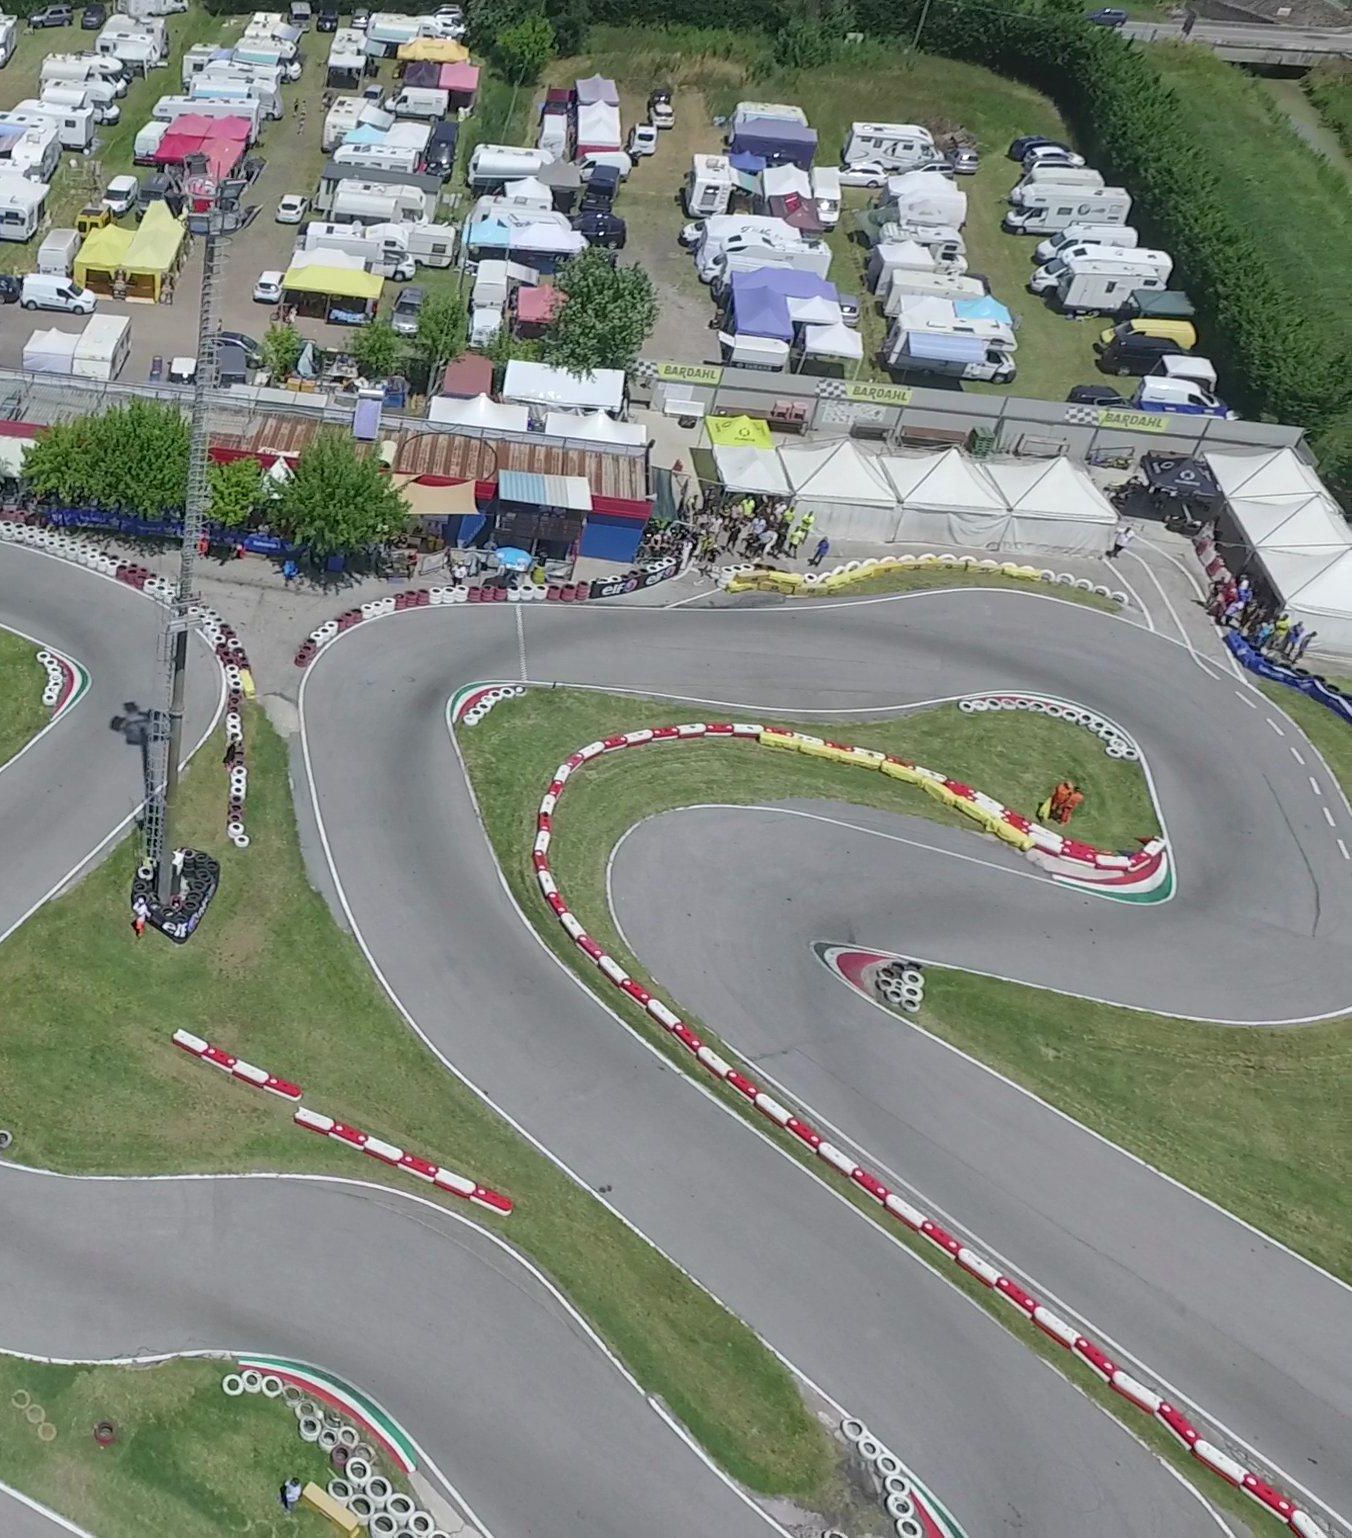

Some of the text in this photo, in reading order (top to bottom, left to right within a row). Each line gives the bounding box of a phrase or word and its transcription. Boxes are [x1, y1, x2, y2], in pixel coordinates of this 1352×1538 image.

[663, 364, 717, 380] BARDAHL
[852, 385, 908, 401] BARDAHL
[1104, 412, 1164, 428] BARDAHL
[601, 585, 626, 596] elf
